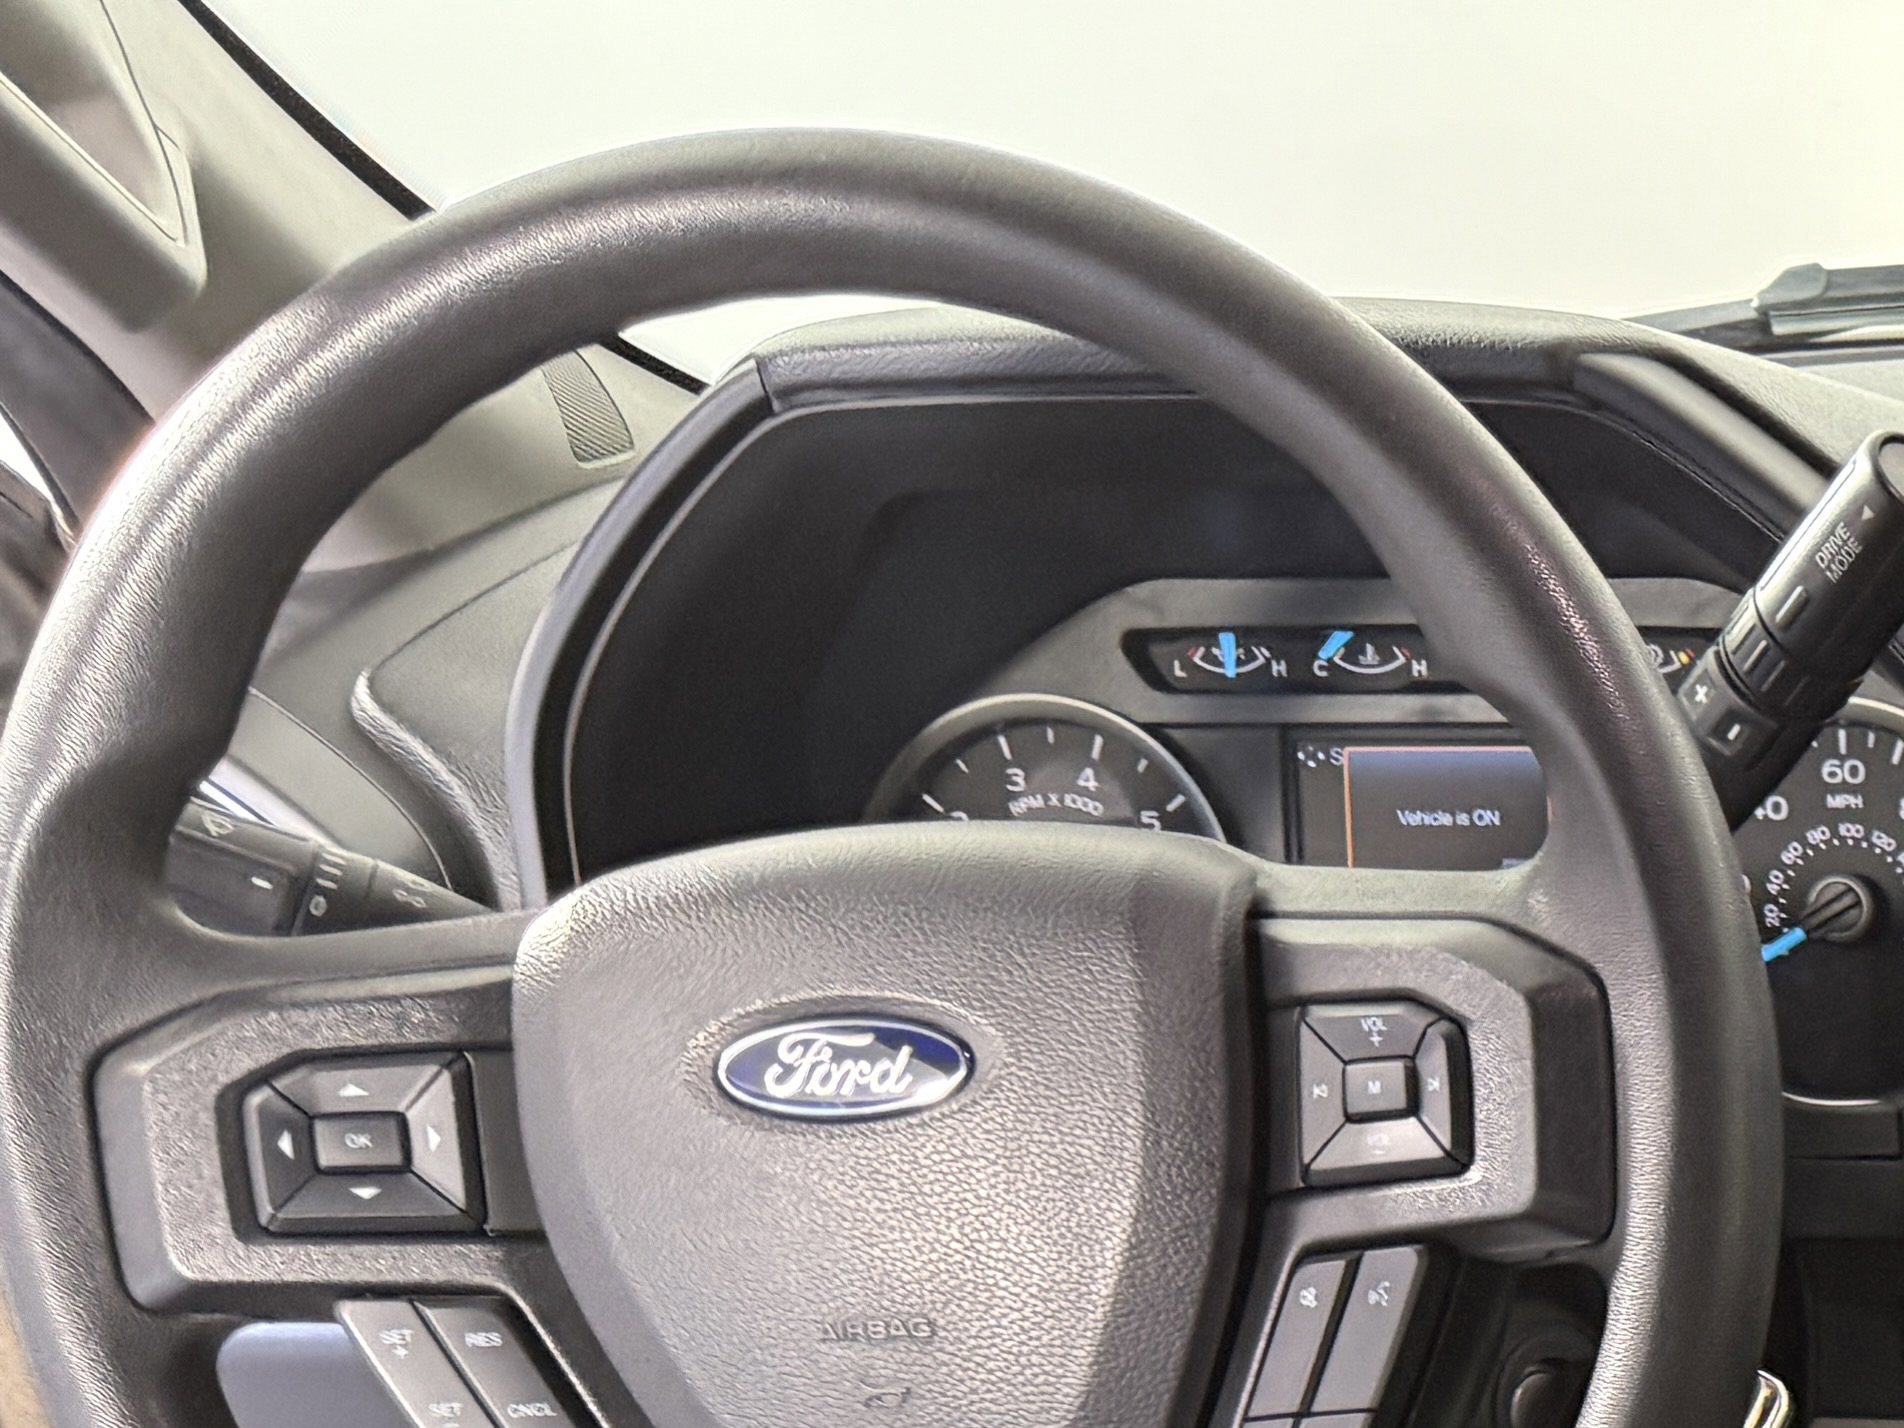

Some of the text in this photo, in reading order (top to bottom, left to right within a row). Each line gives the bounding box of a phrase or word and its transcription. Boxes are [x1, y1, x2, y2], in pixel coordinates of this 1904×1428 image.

[1815, 521, 1851, 568] DRIVE
[1825, 537, 1863, 584] MODE
[1174, 660, 1187, 677] L
[1272, 660, 1287, 677] H
[1313, 660, 1328, 677] C
[1412, 659, 1428, 677] H
[1006, 767, 1026, 792] 3
[1076, 767, 1099, 791] 4
[1821, 758, 1866, 784] 60
[1008, 794, 1045, 816] RPM
[1063, 793, 1104, 817] 1000
[1826, 794, 1864, 809] MPH
[1141, 810, 1161, 832] 5
[1397, 808, 1501, 826] Vehicle is ON
[1805, 825, 1831, 845] 80
[1838, 823, 1864, 838] 100
[1871, 830, 1896, 851] 120
[1780, 841, 1803, 865] 60
[1766, 870, 1784, 895] 40
[1764, 903, 1781, 927] 20
[764, 1031, 912, 1098] Ford
[345, 1133, 373, 1148] OK
[820, 1318, 933, 1342] AIRBAG
